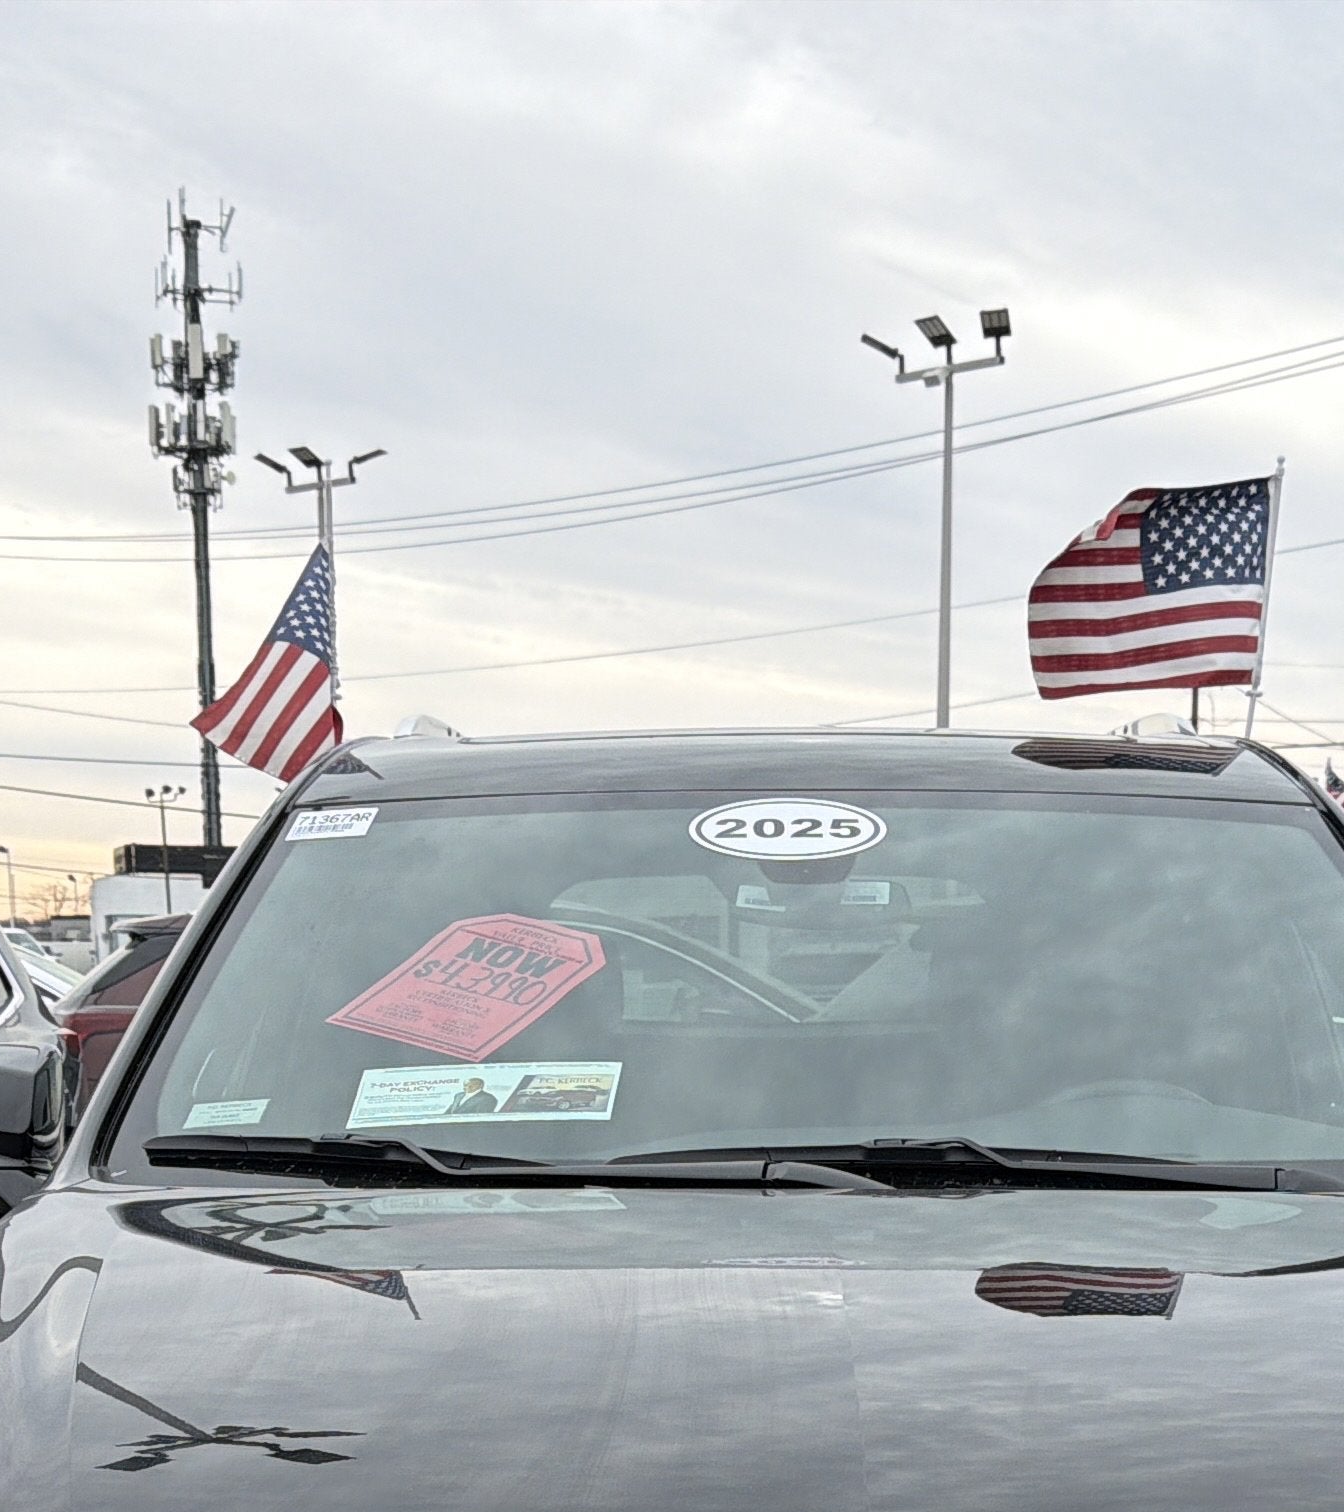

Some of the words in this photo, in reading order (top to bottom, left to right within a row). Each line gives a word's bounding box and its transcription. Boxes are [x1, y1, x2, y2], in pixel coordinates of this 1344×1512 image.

[298, 812, 373, 826] 71367AR
[714, 818, 862, 839] 2025
[455, 936, 568, 979] NOW
[403, 1078, 460, 1087] EXCHANGE
